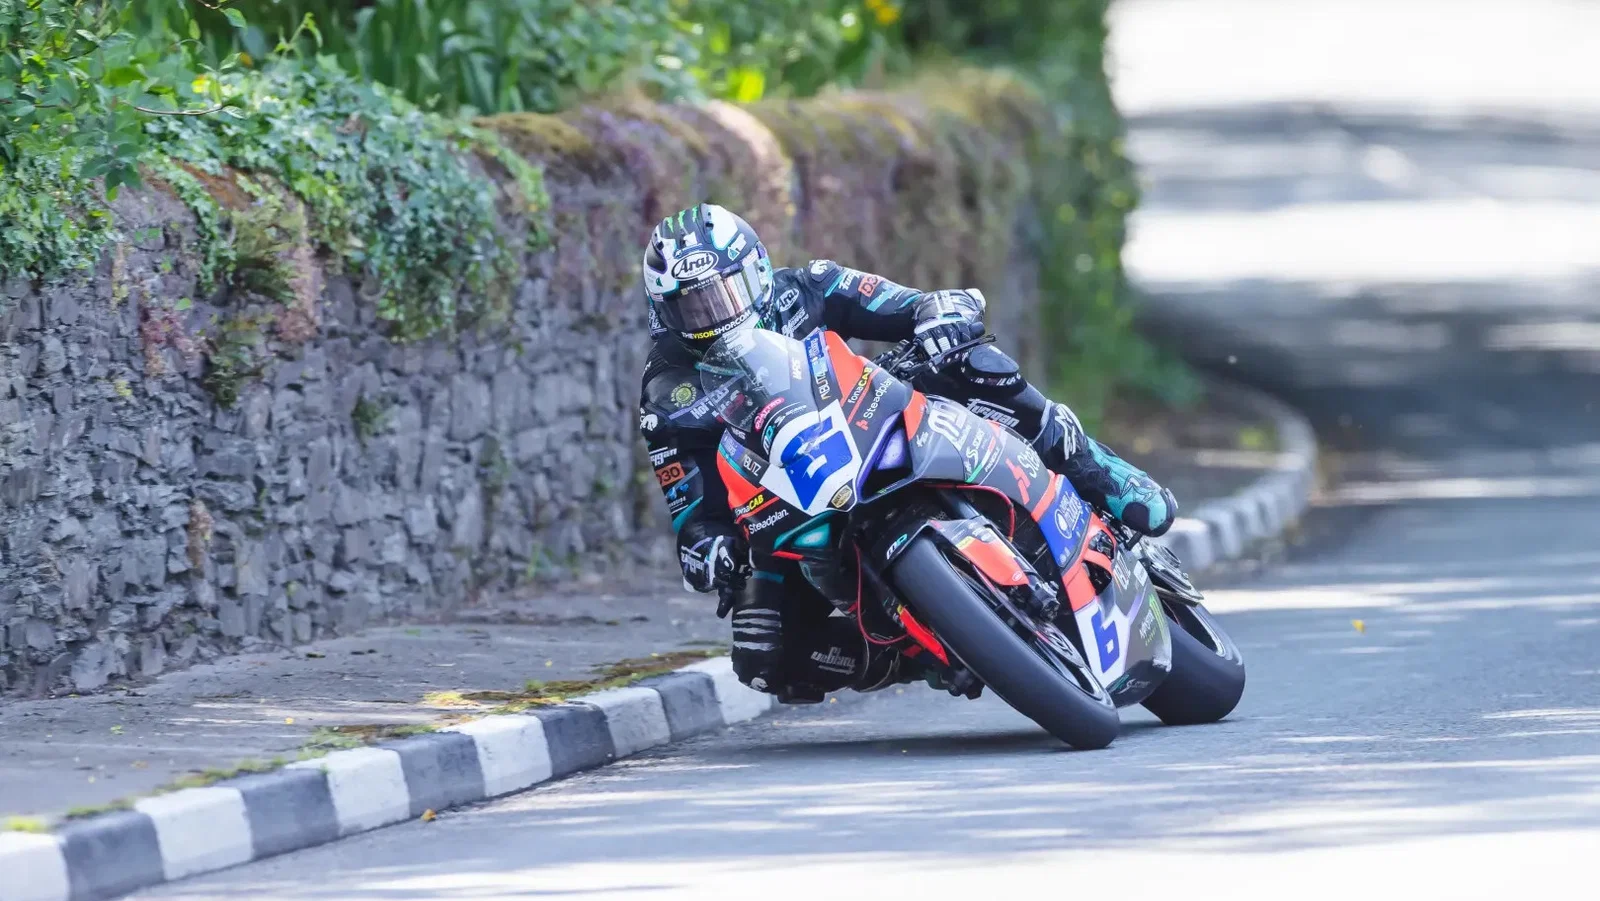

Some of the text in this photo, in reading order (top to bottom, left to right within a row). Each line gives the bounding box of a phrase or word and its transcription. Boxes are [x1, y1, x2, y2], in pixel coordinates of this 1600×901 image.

[676, 252, 713, 276] Arai
[778, 291, 799, 308] Arai
[681, 310, 752, 340] THEVISORSHOP.COM
[848, 366, 874, 404] fonaCAB
[966, 398, 1020, 427] Furygan
[743, 455, 762, 476] BLITZ
[734, 494, 764, 518] fonaCAB
[1091, 609, 1120, 674] 6
